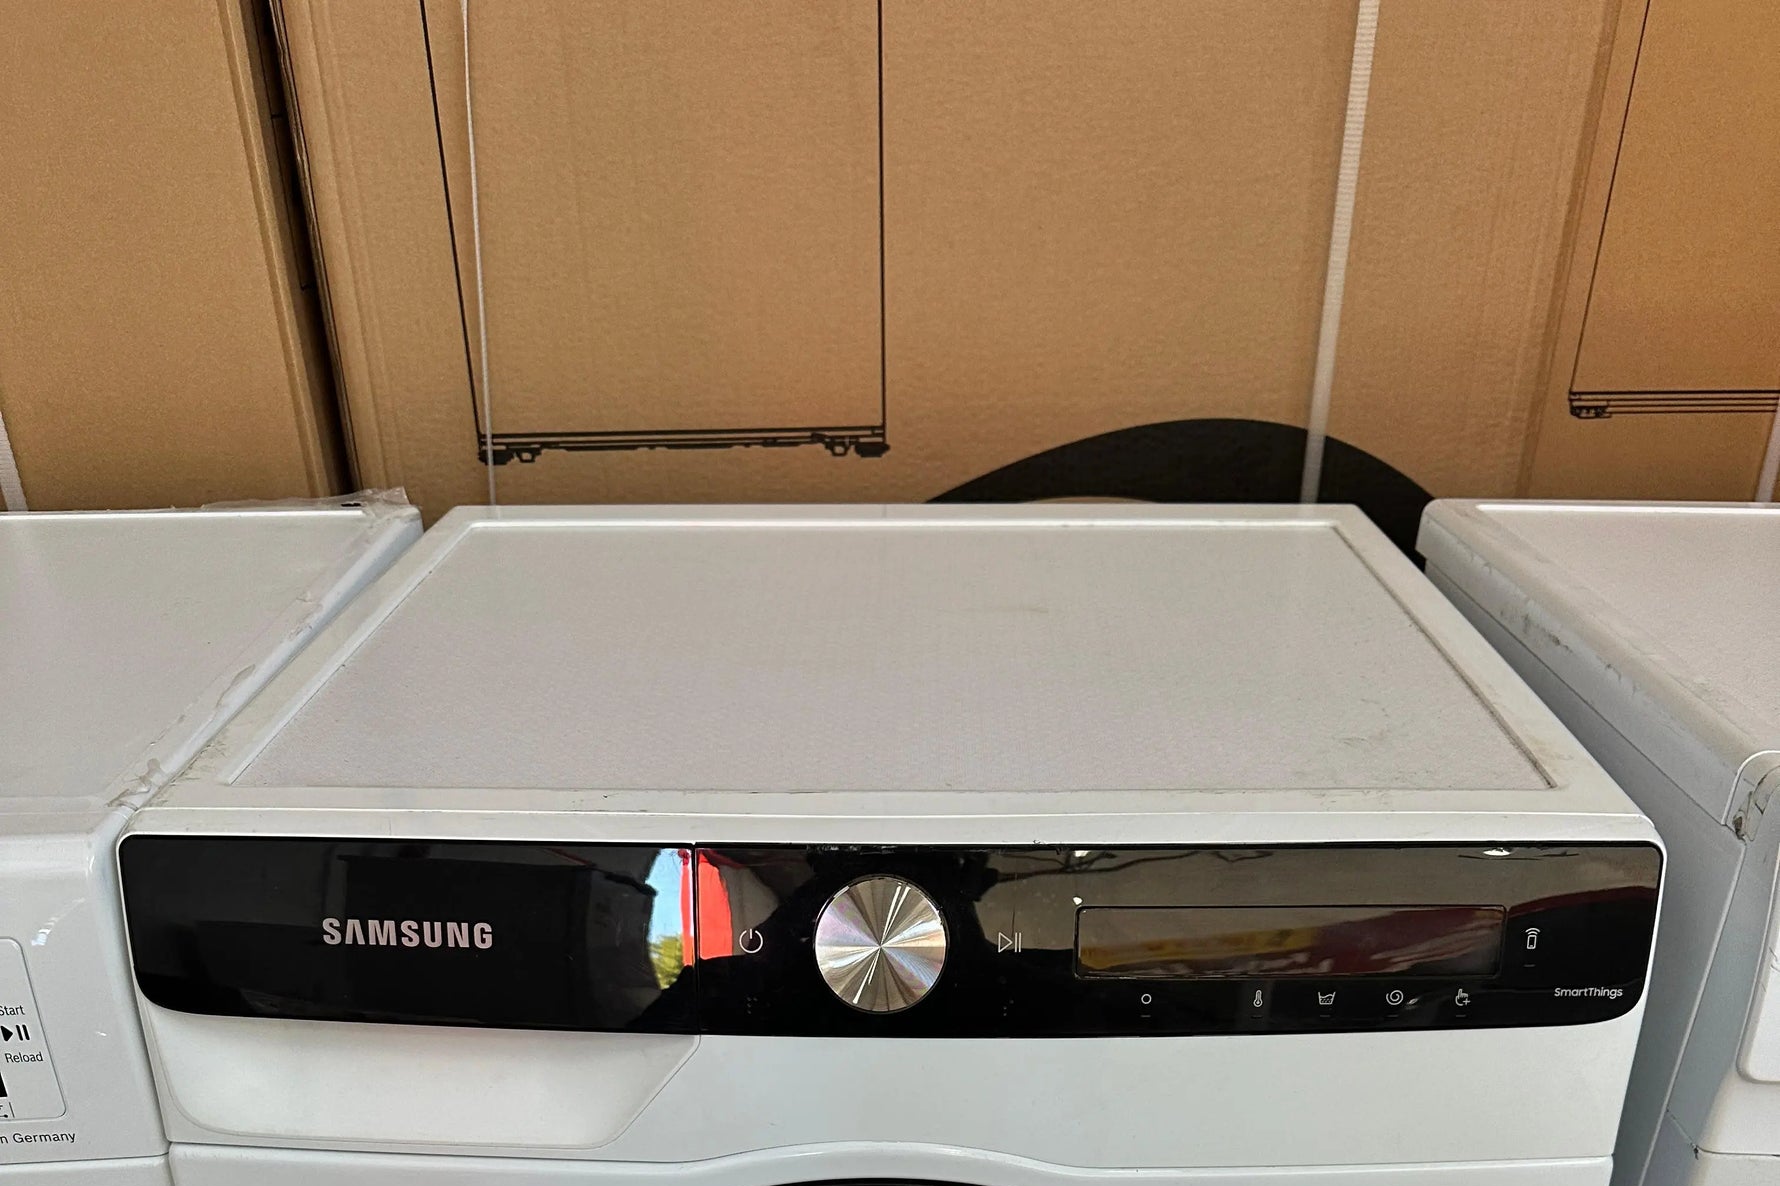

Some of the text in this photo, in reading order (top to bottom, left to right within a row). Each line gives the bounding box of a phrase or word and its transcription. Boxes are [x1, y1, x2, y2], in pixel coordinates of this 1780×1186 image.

[322, 917, 493, 949] SAMSUNG
[1554, 987, 1623, 999] SmartThings
[5, 1052, 43, 1063] Reload
[13, 1133, 75, 1144] Germany
